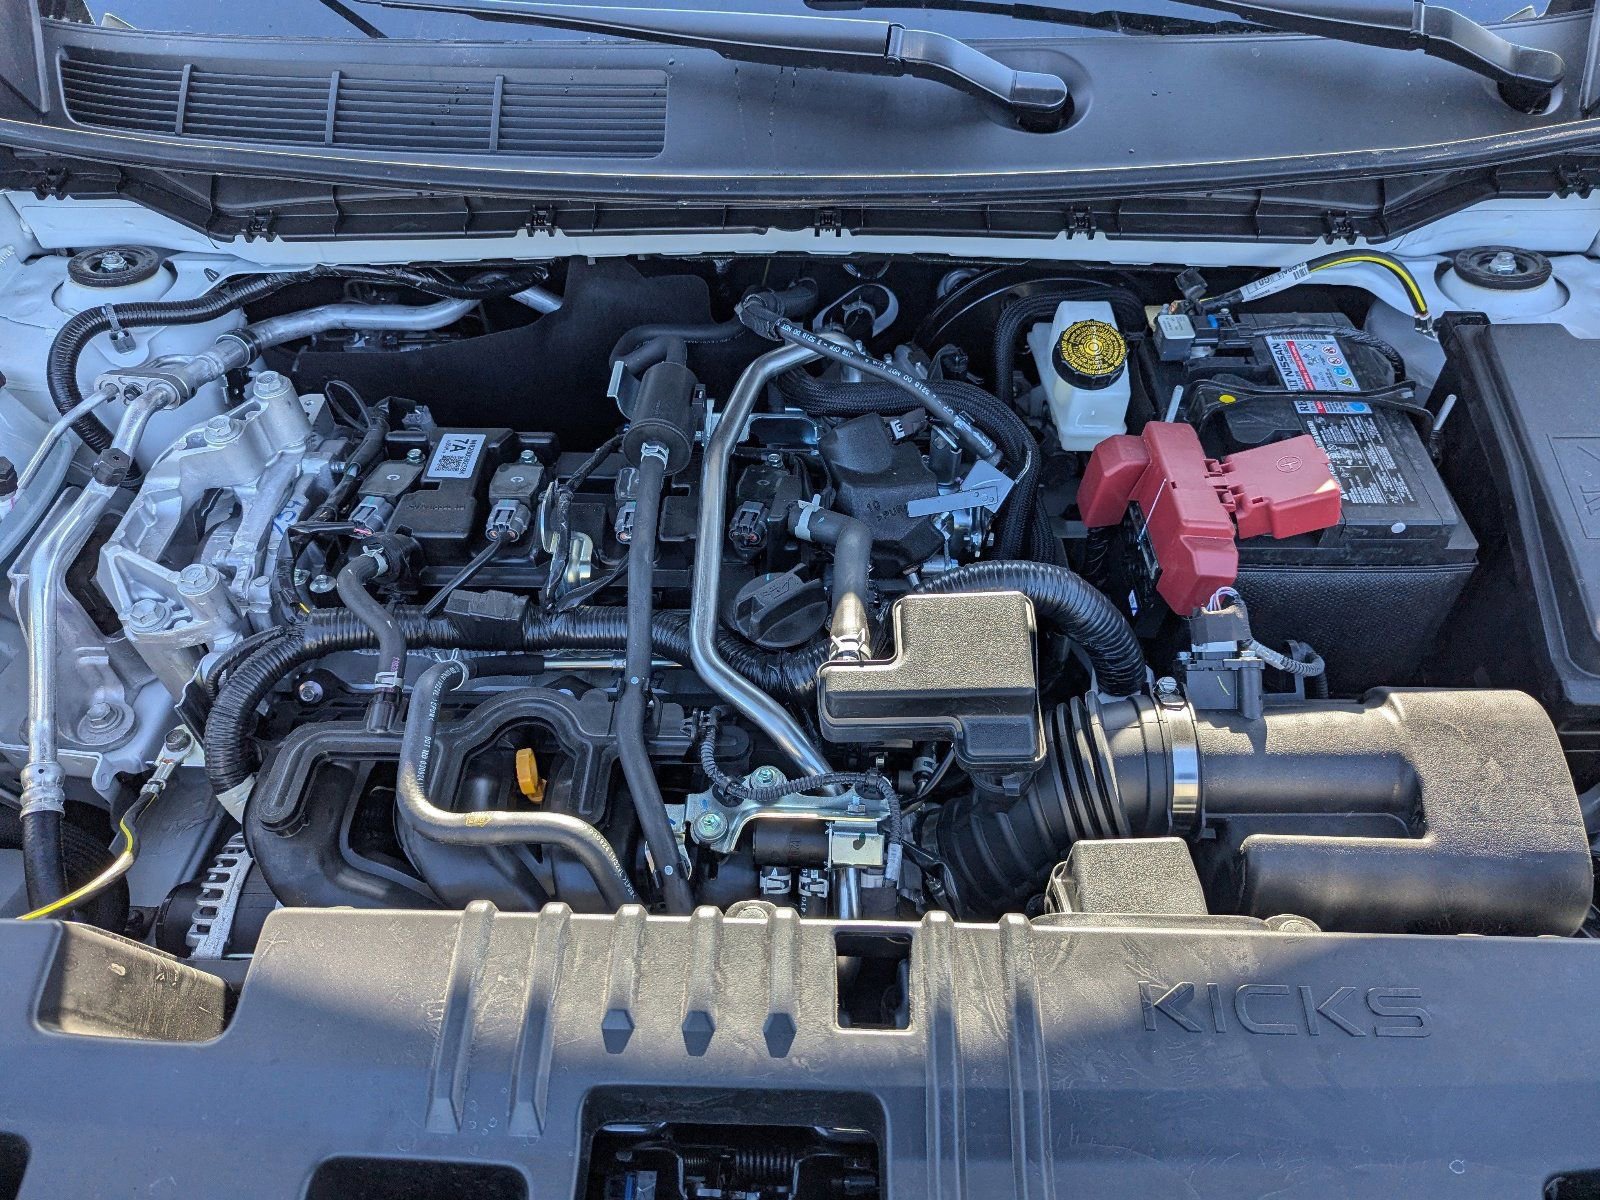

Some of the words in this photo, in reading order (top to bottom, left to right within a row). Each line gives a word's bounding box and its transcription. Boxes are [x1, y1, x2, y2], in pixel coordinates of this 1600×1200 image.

[1271, 342, 1295, 378] NISSAN
[449, 438, 470, 453] 7A
[1137, 980, 1433, 1038] KICKS
